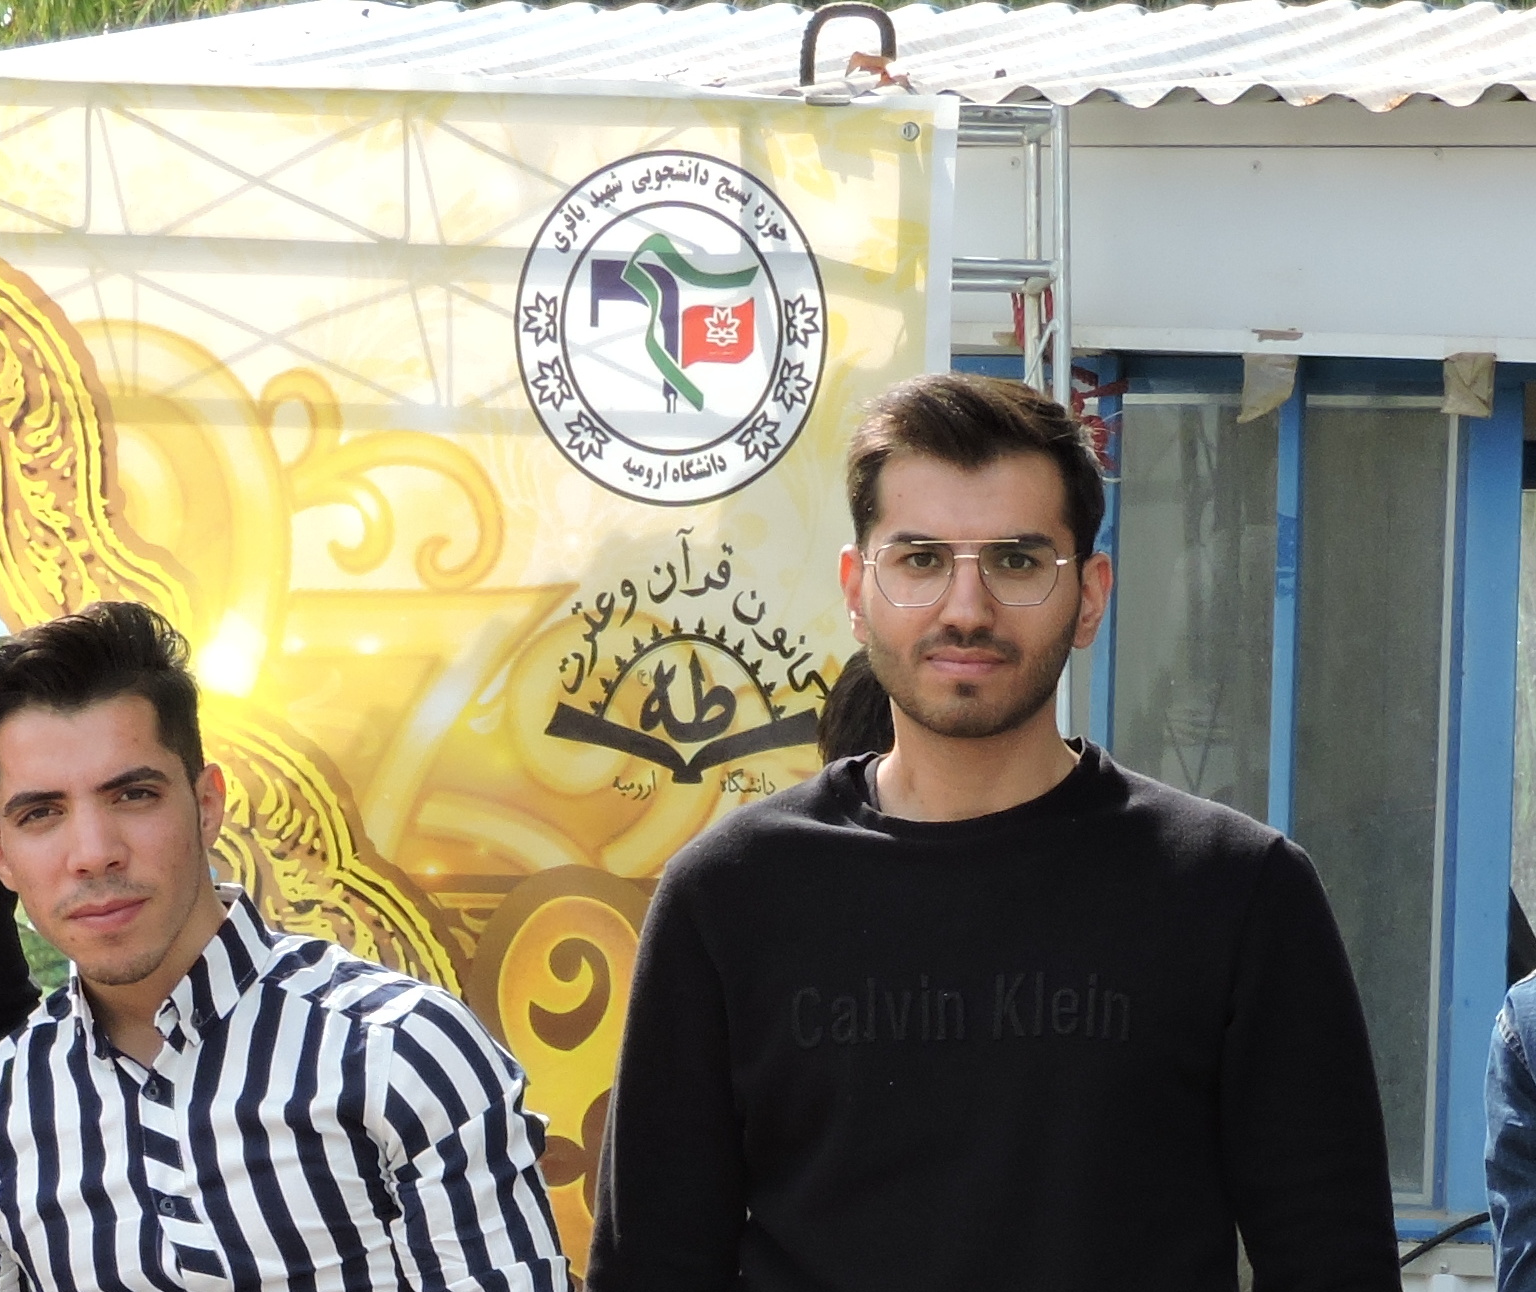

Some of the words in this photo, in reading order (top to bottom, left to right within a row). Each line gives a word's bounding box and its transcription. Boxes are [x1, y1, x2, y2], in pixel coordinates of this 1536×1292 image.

[589, 171, 624, 209] شهید
[631, 159, 710, 195] دانشجویی
[714, 173, 753, 211] بسیج
[553, 203, 587, 255] باقری
[754, 204, 788, 243] حوزه
[621, 455, 669, 490] ارومیه
[671, 453, 728, 485] دانشگاه
[647, 526, 735, 605] قرآن
[558, 590, 617, 695] عترت
[731, 588, 832, 701] کانون
[638, 648, 738, 744] طه
[612, 770, 657, 801] ارومیه
[719, 768, 777, 797] دانشگاه
[791, 973, 964, 1049] Calvin
[992, 971, 1132, 1043] Klein
